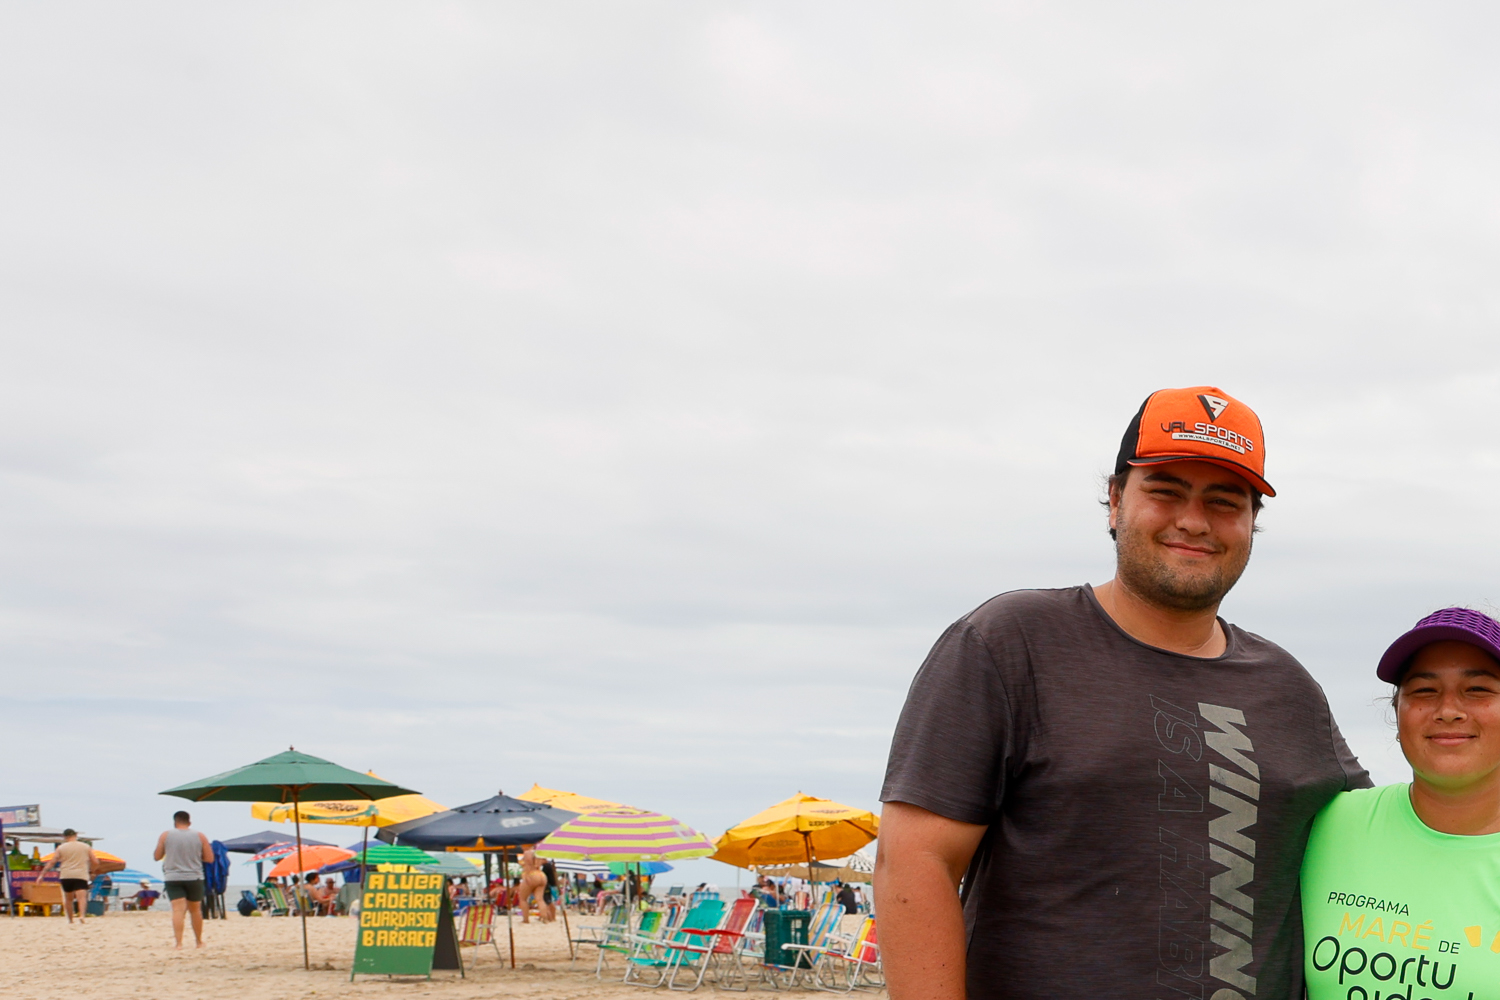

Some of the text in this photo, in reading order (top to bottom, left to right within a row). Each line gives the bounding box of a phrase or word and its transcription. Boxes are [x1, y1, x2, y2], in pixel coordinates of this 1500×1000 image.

[1149, 693, 1203, 762] IS
[1157, 758, 1204, 813] A
[1326, 891, 1410, 917] PROGRAMA
[362, 930, 438, 947] BARRACA
[1337, 911, 1461, 955] MARÉ DE
[1312, 935, 1457, 990] Oportu
